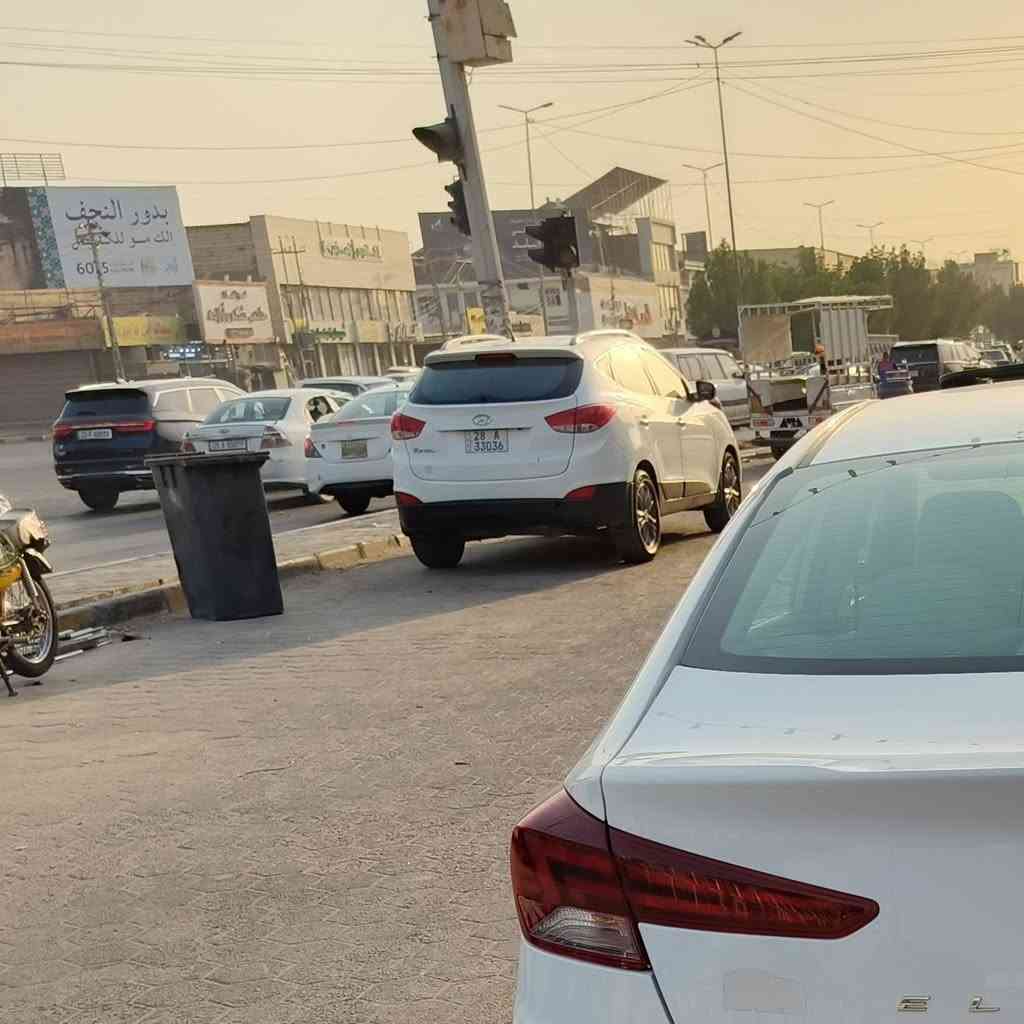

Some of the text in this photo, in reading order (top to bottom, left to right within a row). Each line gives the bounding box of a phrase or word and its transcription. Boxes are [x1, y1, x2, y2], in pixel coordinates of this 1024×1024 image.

[64, 199, 169, 226] بدور النجف
[76, 261, 110, 275] 605
[473, 431, 486, 441] 28
